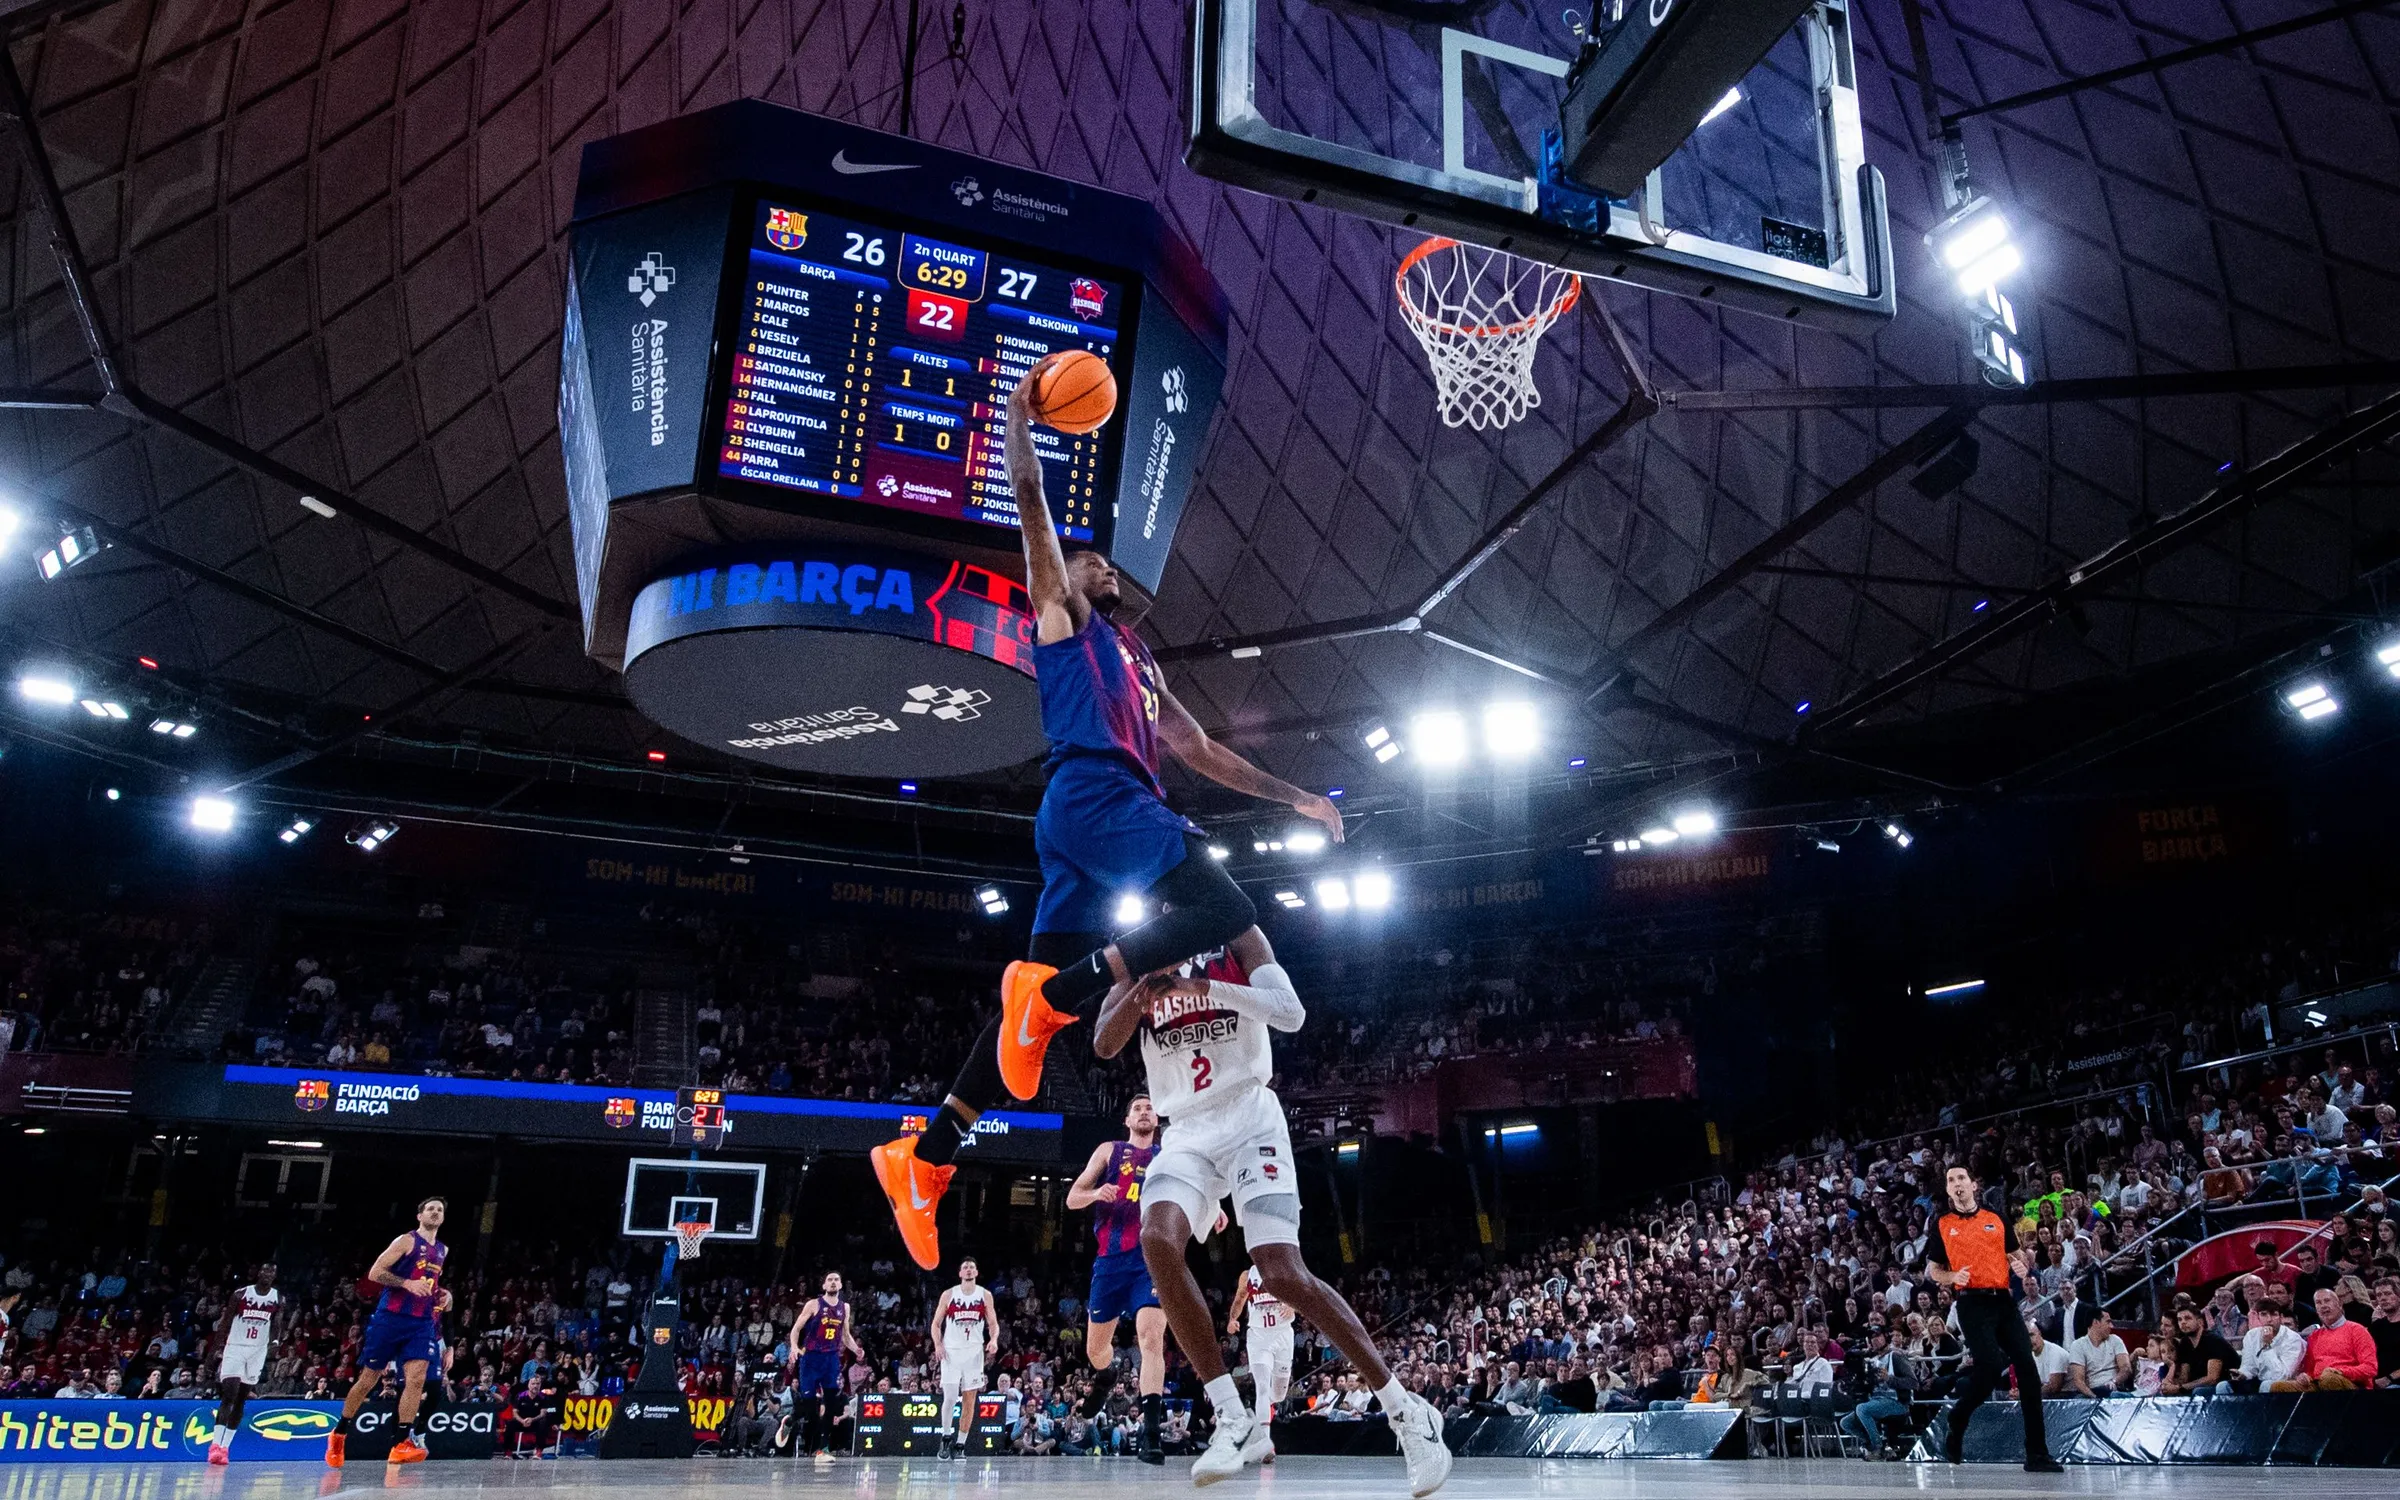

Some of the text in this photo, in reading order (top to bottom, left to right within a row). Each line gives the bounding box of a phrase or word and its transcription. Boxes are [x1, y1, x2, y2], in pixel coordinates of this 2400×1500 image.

[992, 188, 1069, 216] Assistència
[992, 200, 1046, 222] Sanitària
[843, 232, 886, 266] 26
[914, 244, 976, 267] 2n QUART
[800, 264, 836, 281] BARÇA
[918, 262, 967, 290] 6:29
[998, 268, 1038, 300] 27
[756, 281, 880, 316] 0 PUNTER 0 5
[857, 290, 864, 299] F
[753, 312, 876, 346] 3 CALE 1 0
[755, 298, 878, 332] 2 MARCOS 1 2
[919, 302, 954, 331] 22
[1028, 316, 1078, 335] BASKONIA
[751, 328, 874, 362] 6 VESELY 1 5
[996, 334, 1048, 354] 0 HOWARD
[996, 350, 1000, 358] 1
[1087, 342, 1094, 351] F
[632, 322, 650, 412] Sanitària
[748, 343, 872, 377] 8 BRIZUELA 0 0
[913, 353, 948, 368] FALTES
[992, 364, 999, 373] 2
[651, 318, 669, 446] Assistència
[742, 358, 870, 392] 13 SATORANSKY 0 0
[902, 369, 954, 396] 1 1
[990, 379, 998, 388] 4
[738, 374, 868, 407] 14 HERNANGÓMEZ 1 9
[988, 394, 996, 402] 6
[737, 388, 866, 422] 19 FALL 0 0
[892, 406, 956, 428] TEMPS MORT
[732, 404, 864, 438] 20 LAPROVITTOLA 1 0
[987, 408, 1099, 439] 7 0
[732, 420, 862, 452] 21 CLYBURN 1 5
[894, 424, 950, 450] 1 0
[984, 424, 992, 432] 8
[1074, 442, 1082, 450] 0
[1090, 444, 1097, 454] 3
[730, 435, 860, 468] 23 SHENGELIA 1 0
[983, 438, 1096, 468] 9 1 5
[1140, 418, 1166, 497] Sanitària
[726, 450, 858, 483] 44 PARRA 0 0
[740, 466, 838, 494] ÓSCAR ORELLANA 0
[976, 452, 988, 461] 10
[1071, 470, 1078, 479] 0
[1087, 474, 1094, 482] 2
[902, 481, 952, 498] Assistència
[974, 466, 986, 476] 18
[1069, 484, 1076, 494] 0
[1085, 488, 1092, 497] 0
[1143, 426, 1176, 540] Assistència
[902, 490, 937, 504] Sanitària
[972, 480, 984, 492] 25
[1068, 499, 1074, 508] 0
[1084, 502, 1090, 512] 0
[970, 496, 1088, 526] 77 0 0
[982, 512, 1010, 524] PAOLO
[1064, 527, 1072, 536] 0
[726, 561, 915, 616] BARÇA
[727, 718, 900, 750] Assistència
[748, 706, 880, 734] Sanitària
[1190, 1056, 1212, 1093] 2
[338, 1082, 420, 1102] FUNDACIÓ
[335, 1098, 389, 1117] BARÇA
[694, 1106, 722, 1126] 21
[864, 1404, 884, 1417] 26
[902, 1404, 938, 1418] 6:29
[980, 1404, 1000, 1417] 27
[865, 1437, 873, 1448] 1
[986, 1437, 994, 1448] 1
